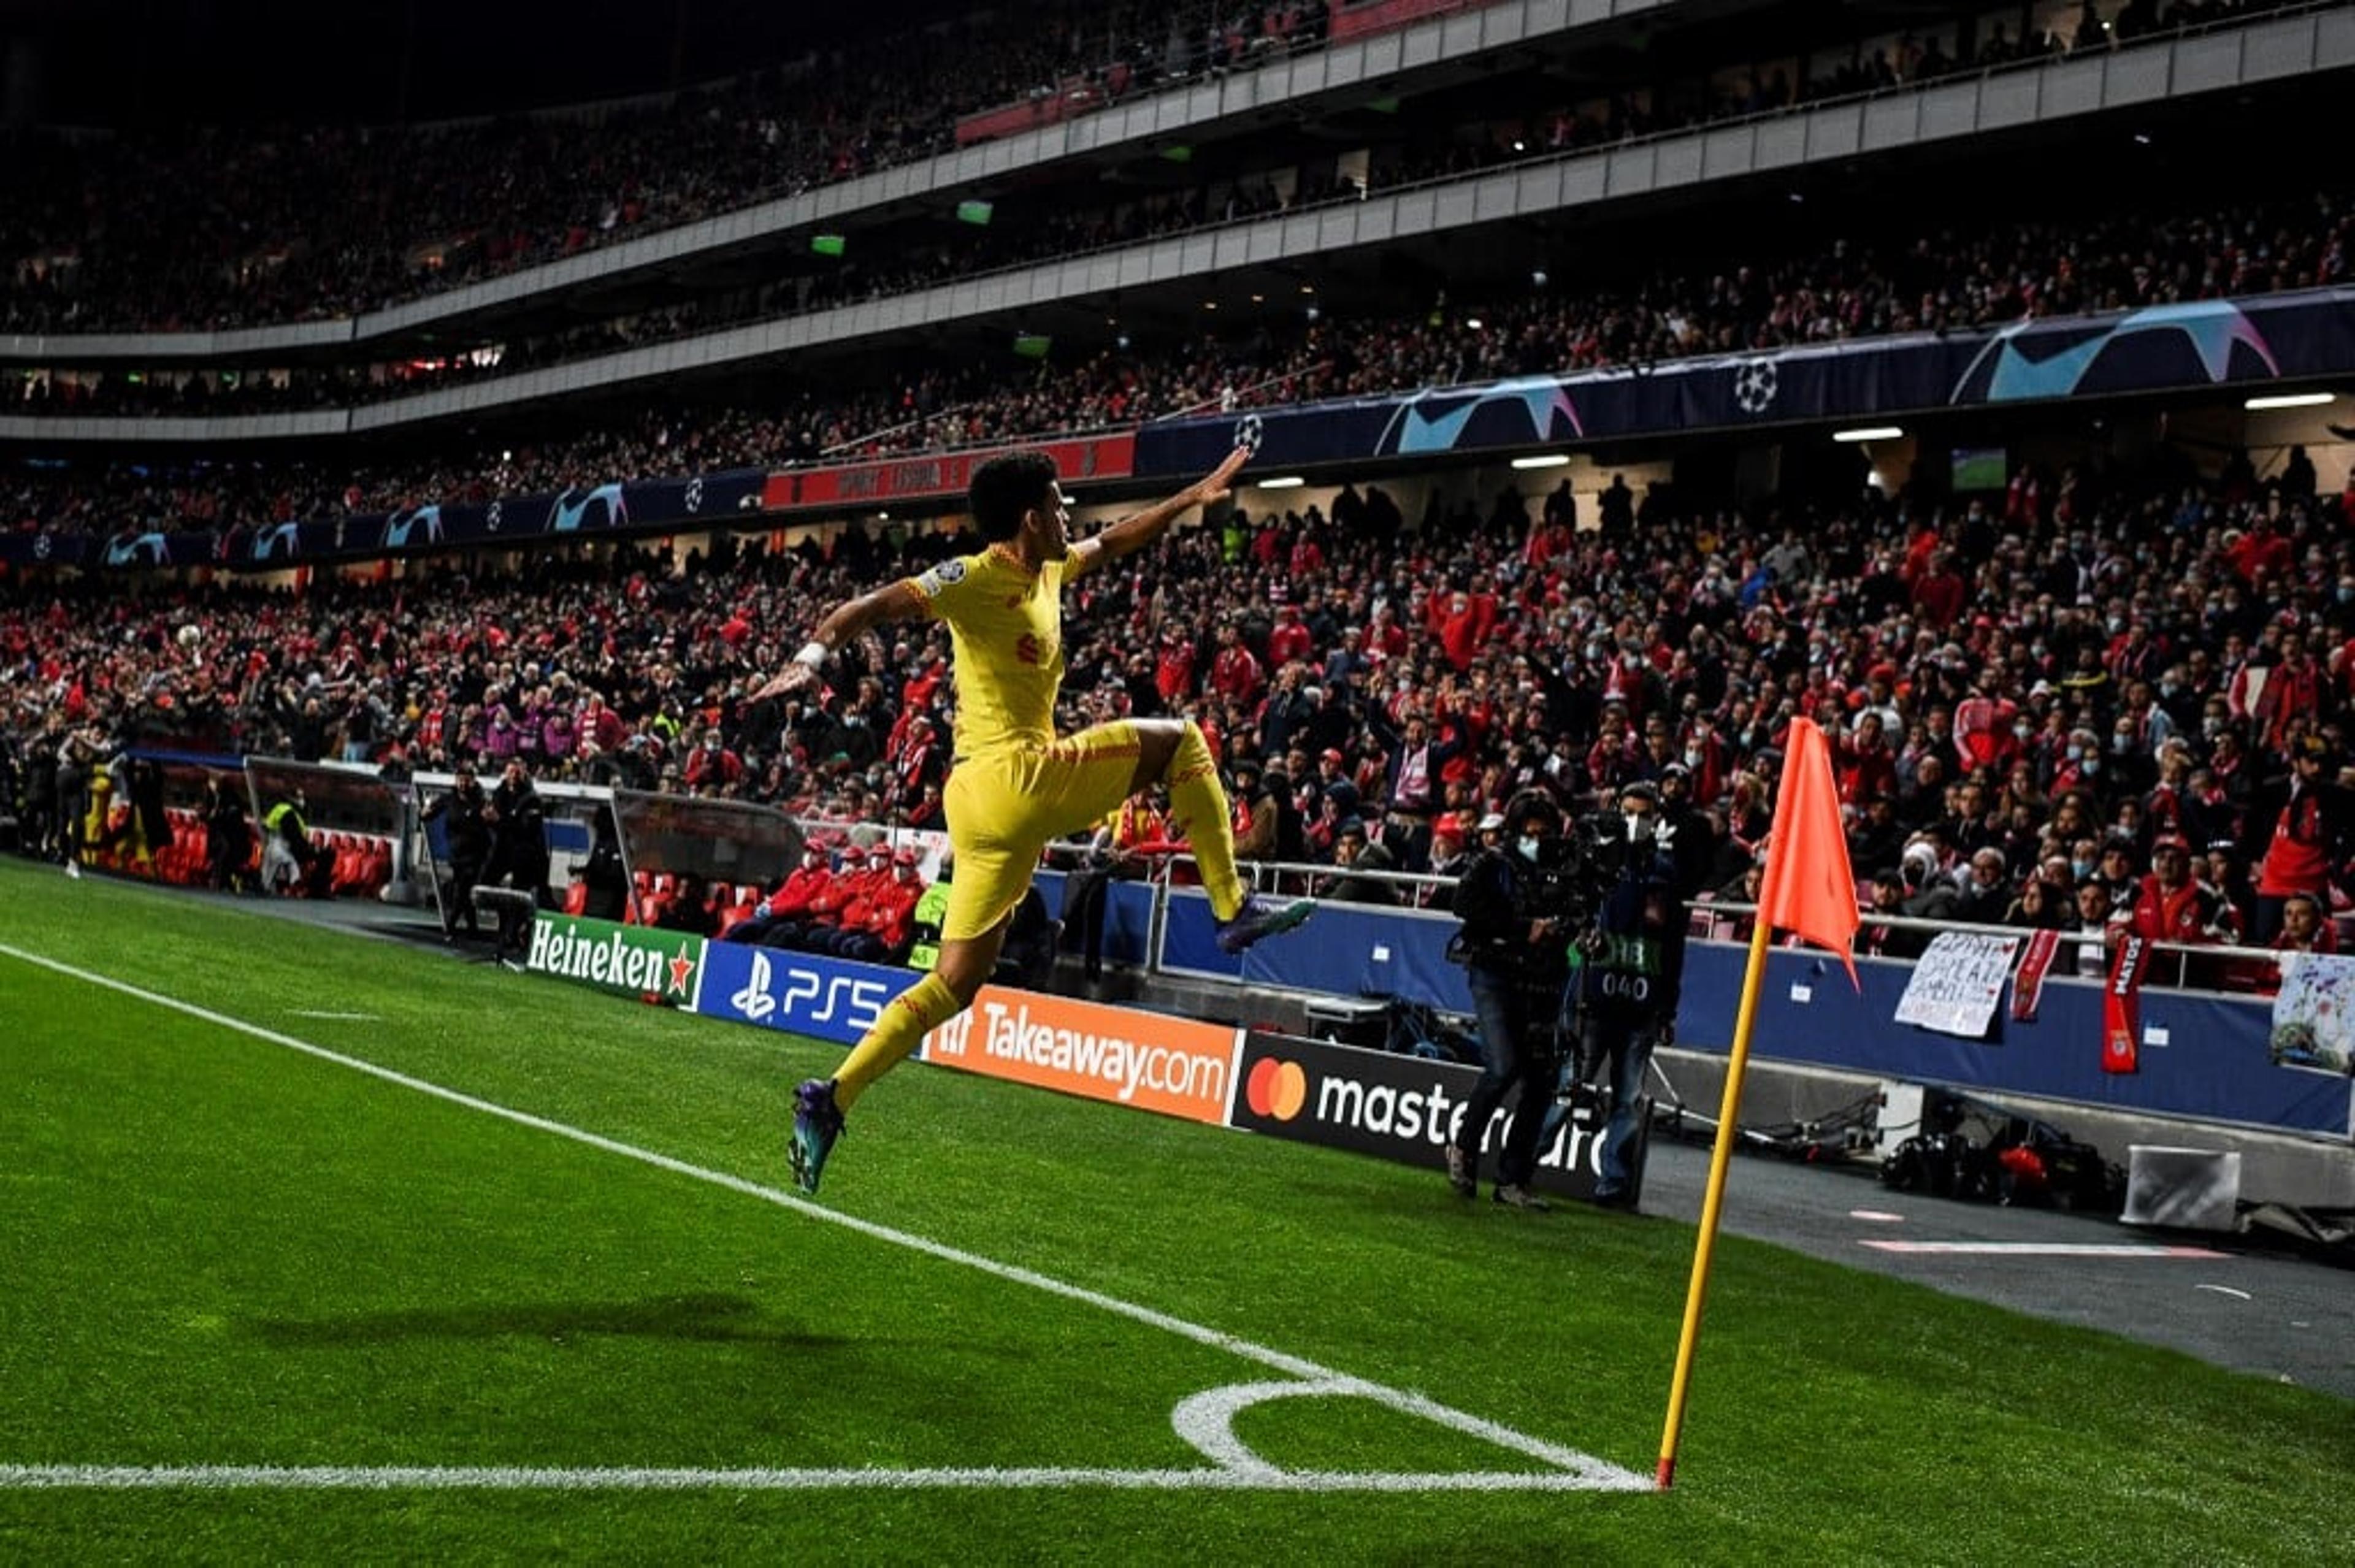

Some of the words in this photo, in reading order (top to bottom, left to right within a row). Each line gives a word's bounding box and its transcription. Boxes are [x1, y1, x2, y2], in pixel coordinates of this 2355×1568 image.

[527, 919, 664, 992] Heineken
[1602, 972, 1648, 1000] 040
[784, 968, 887, 1029] PS5
[984, 1002, 1225, 1101] Takeaway.com
